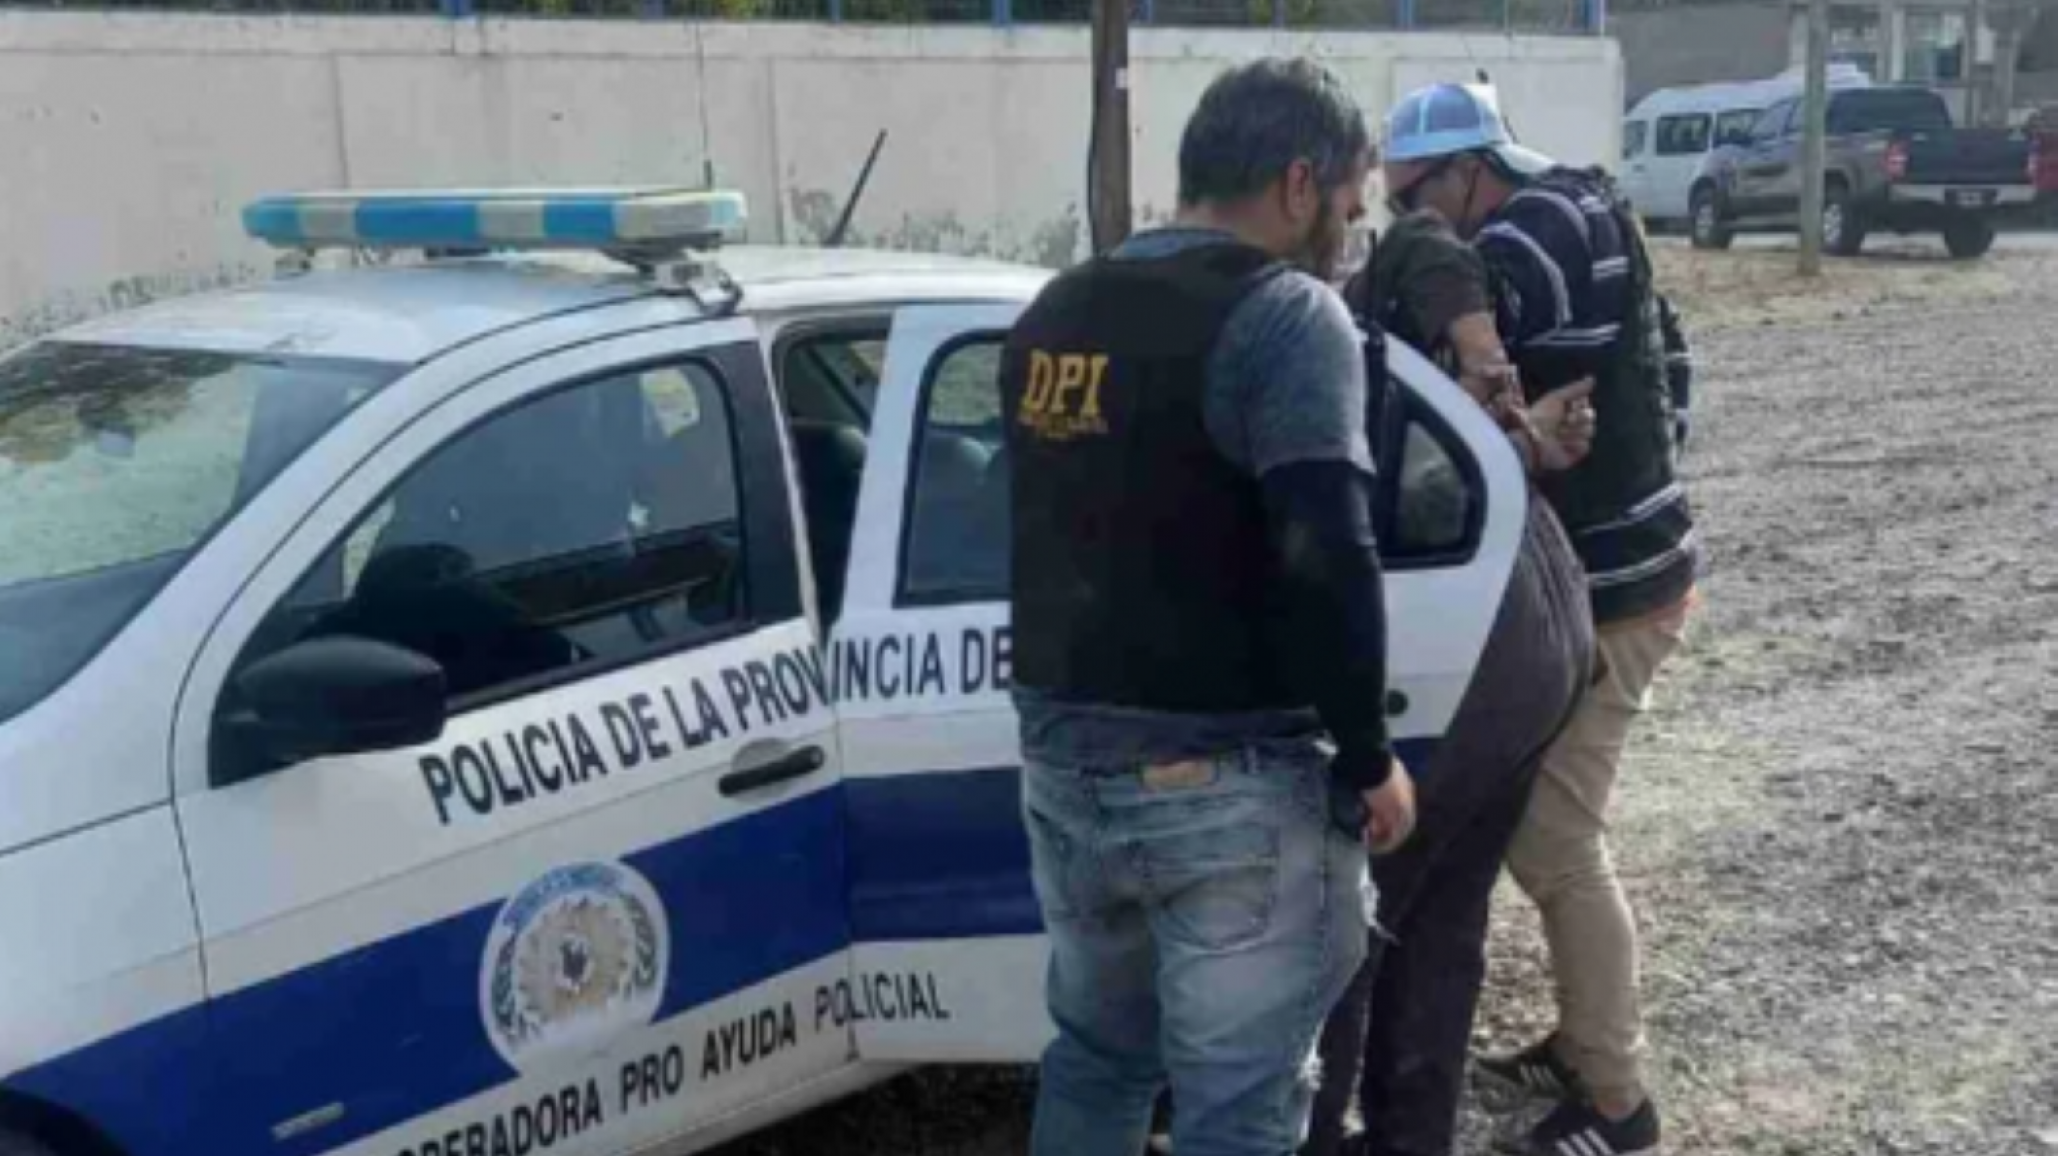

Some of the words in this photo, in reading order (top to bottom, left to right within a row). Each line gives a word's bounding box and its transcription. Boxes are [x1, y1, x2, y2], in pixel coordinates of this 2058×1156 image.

[1021, 348, 1109, 416] DPI
[418, 713, 608, 825] POLICIA
[598, 692, 673, 769] DE
[661, 664, 732, 752] LA
[722, 631, 945, 731] PROVINCIA
[960, 625, 1014, 694] DE
[619, 1045, 684, 1113] PRO
[702, 1001, 798, 1078] AYUDA
[813, 971, 951, 1031] POLICIAL
